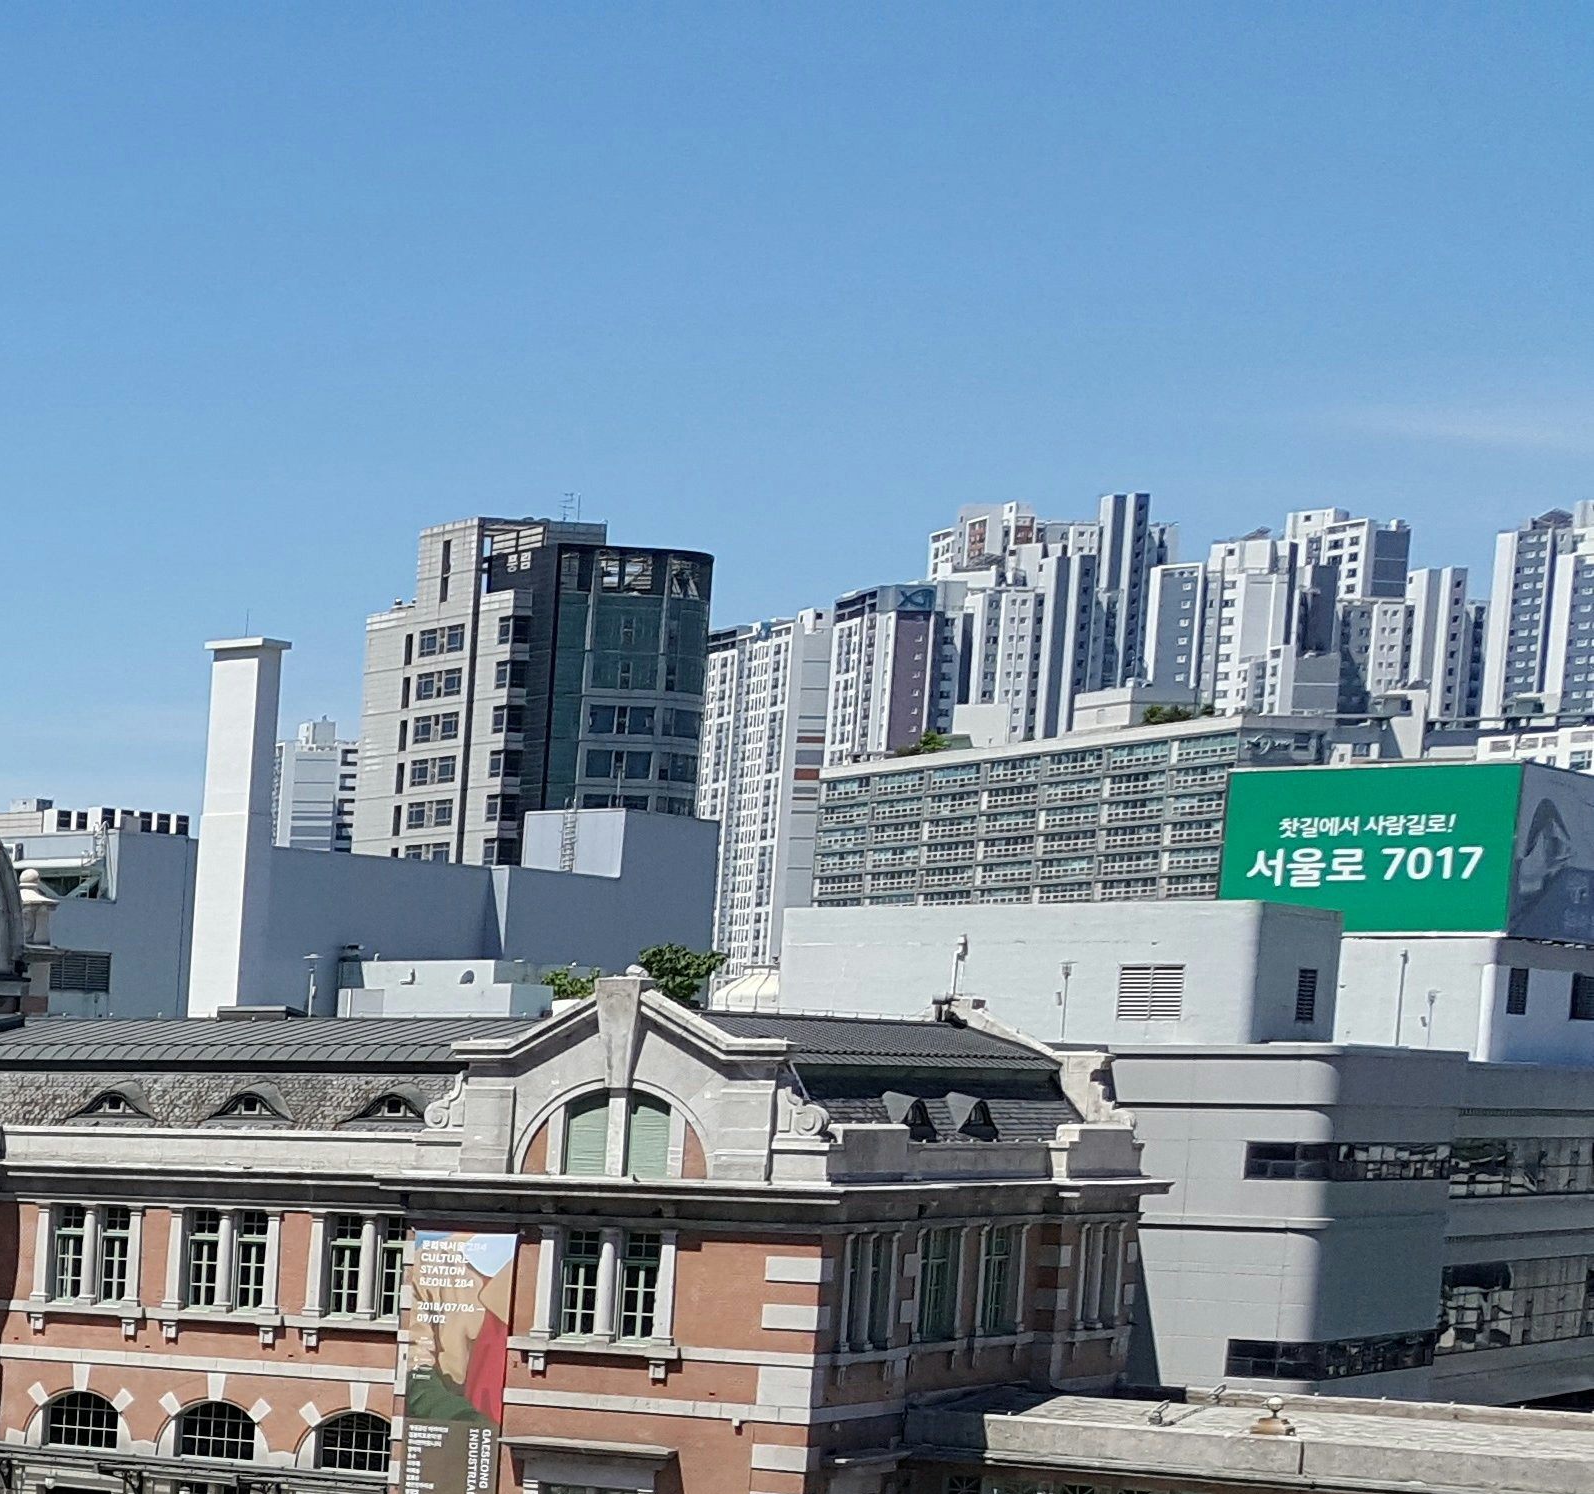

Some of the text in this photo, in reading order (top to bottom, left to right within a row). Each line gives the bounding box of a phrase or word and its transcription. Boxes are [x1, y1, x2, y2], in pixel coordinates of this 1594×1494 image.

[1278, 814, 1457, 838] 찻길에서 사람길로!
[1246, 846, 1485, 888] 서울로 7017
[421, 1253, 469, 1263] CULTURE
[420, 1265, 465, 1276] STATION
[419, 1277, 453, 1287] SEOUL
[417, 1301, 474, 1313] 2018/07/06
[478, 1428, 492, 1490] GAESEONG
